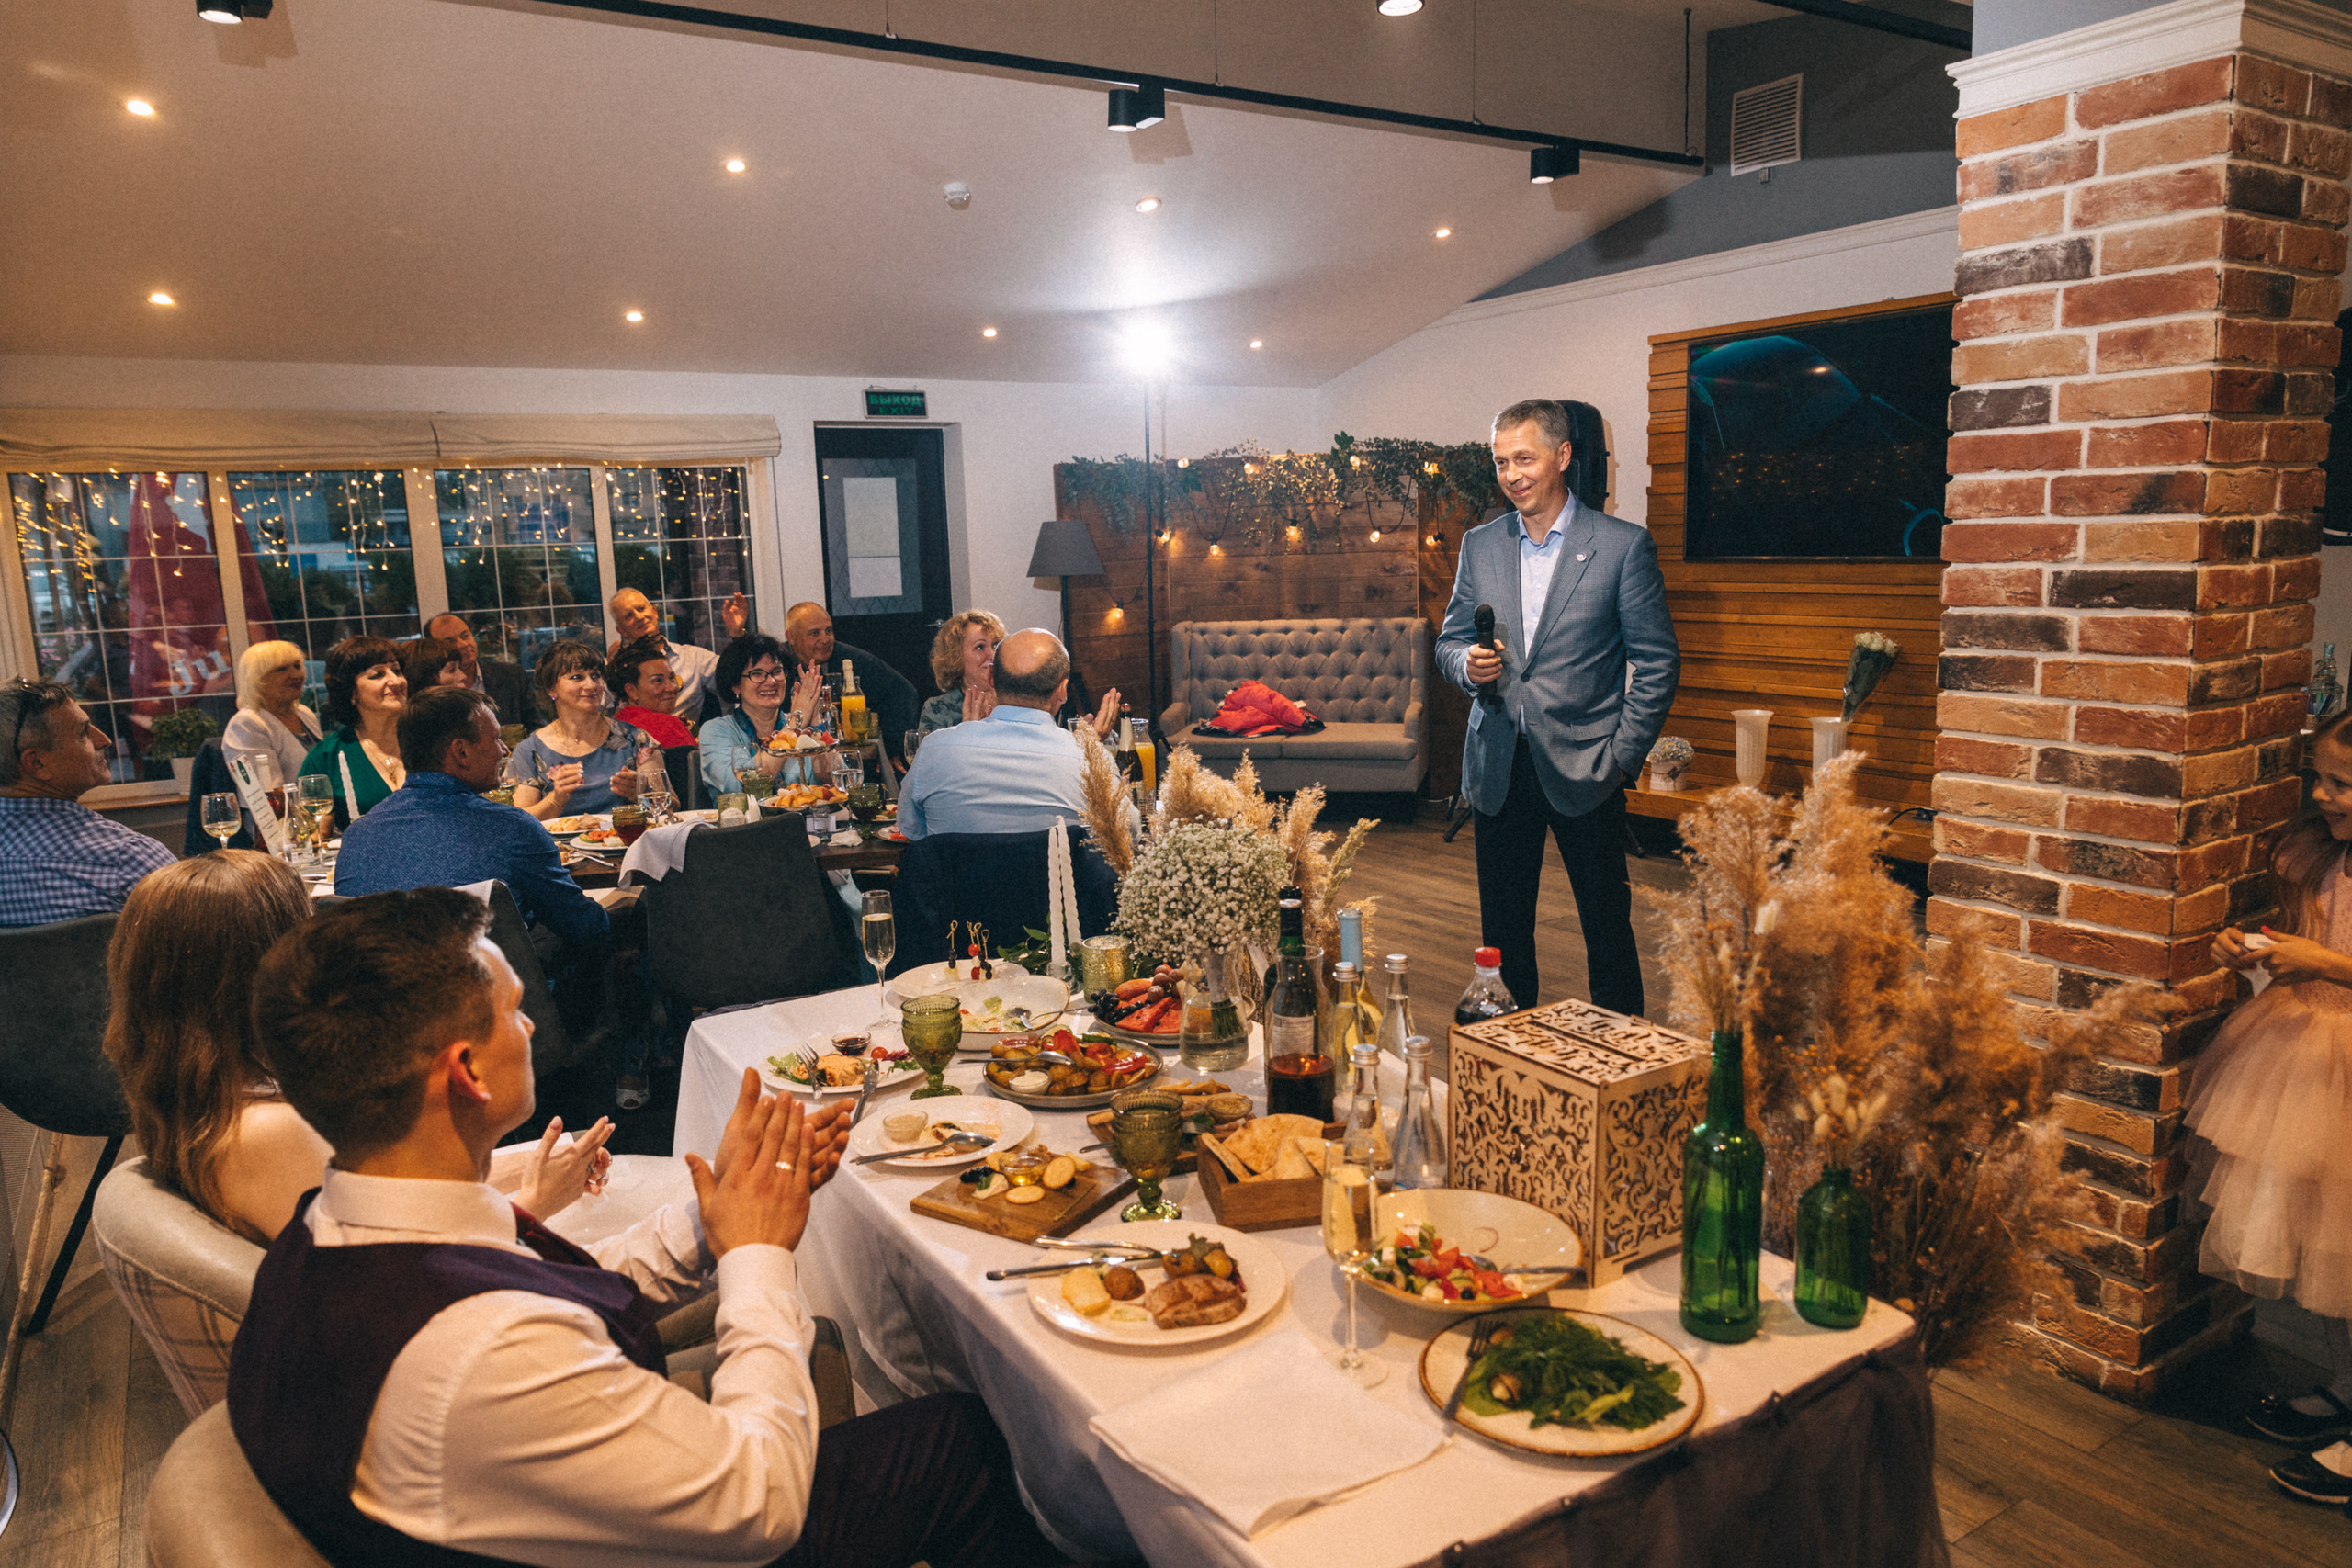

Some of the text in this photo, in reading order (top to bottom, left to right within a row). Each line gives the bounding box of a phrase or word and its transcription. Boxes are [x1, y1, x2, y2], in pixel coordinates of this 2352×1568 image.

[870, 394, 922, 407] ВЫХОД
[879, 407, 913, 415] EXIT
[169, 649, 232, 696] Ju
